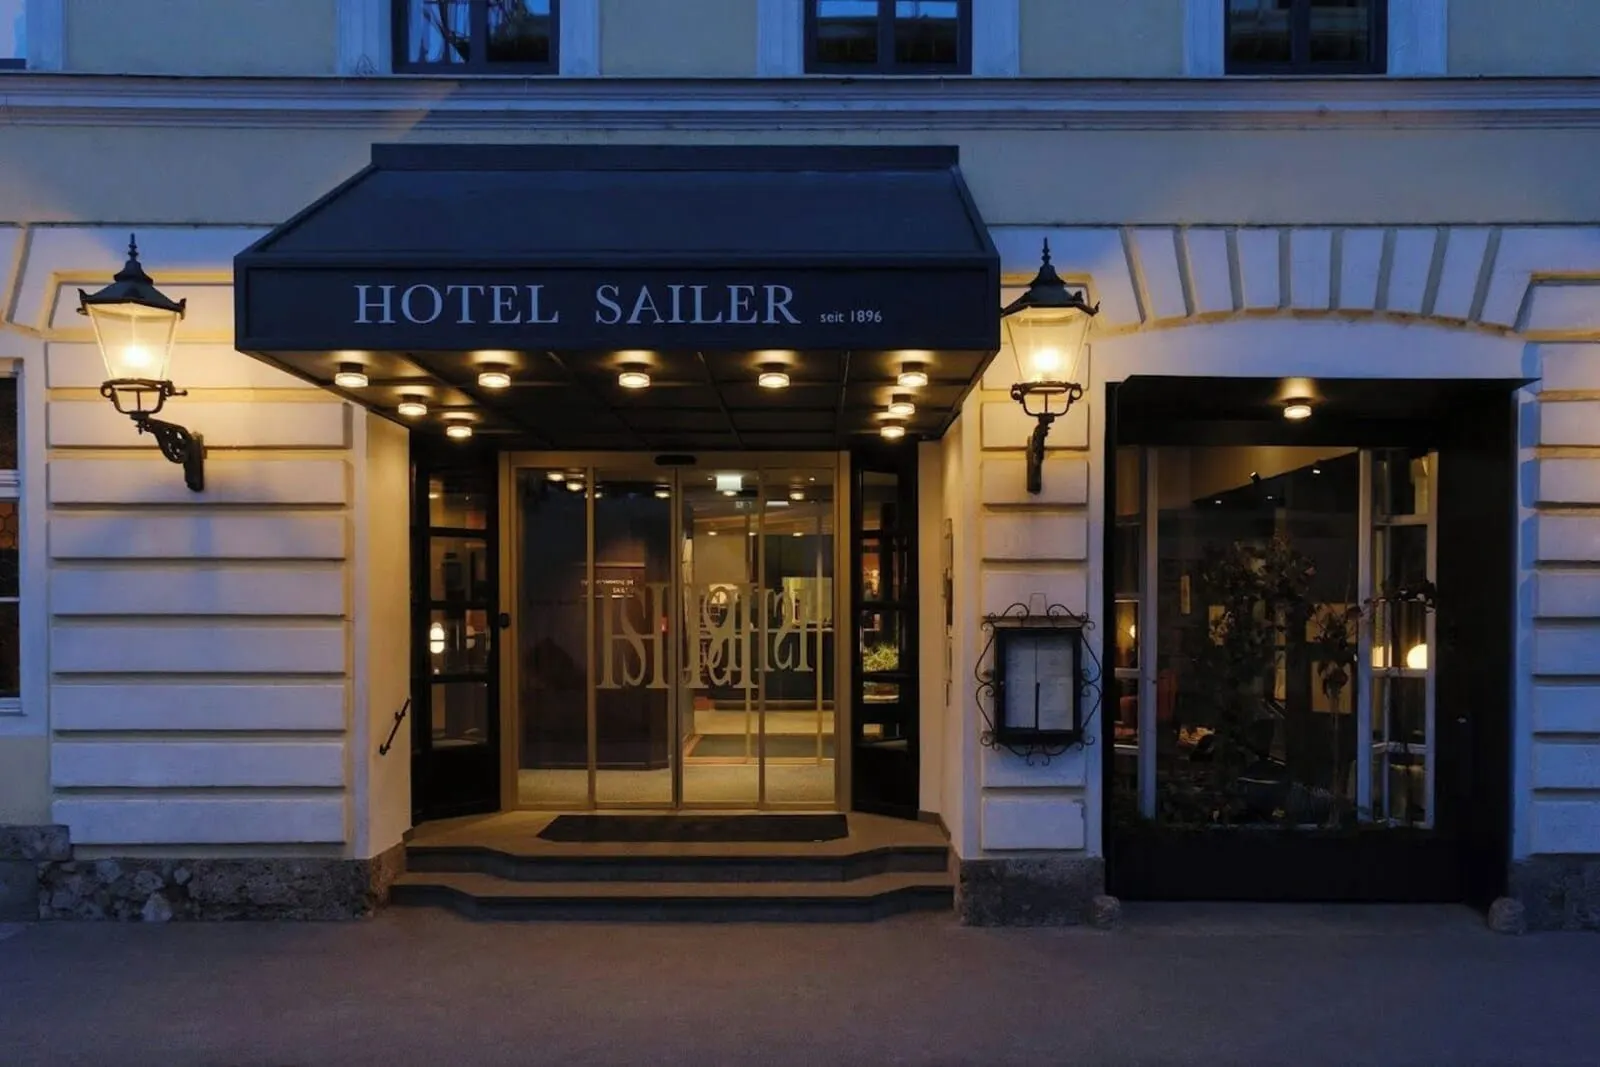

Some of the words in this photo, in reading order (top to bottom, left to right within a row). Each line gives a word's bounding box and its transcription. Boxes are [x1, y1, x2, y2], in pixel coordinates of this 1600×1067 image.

[354, 284, 559, 324] HOTEL
[595, 284, 800, 324] SAILER
[820, 311, 845, 323] seit
[851, 310, 883, 323] 1896
